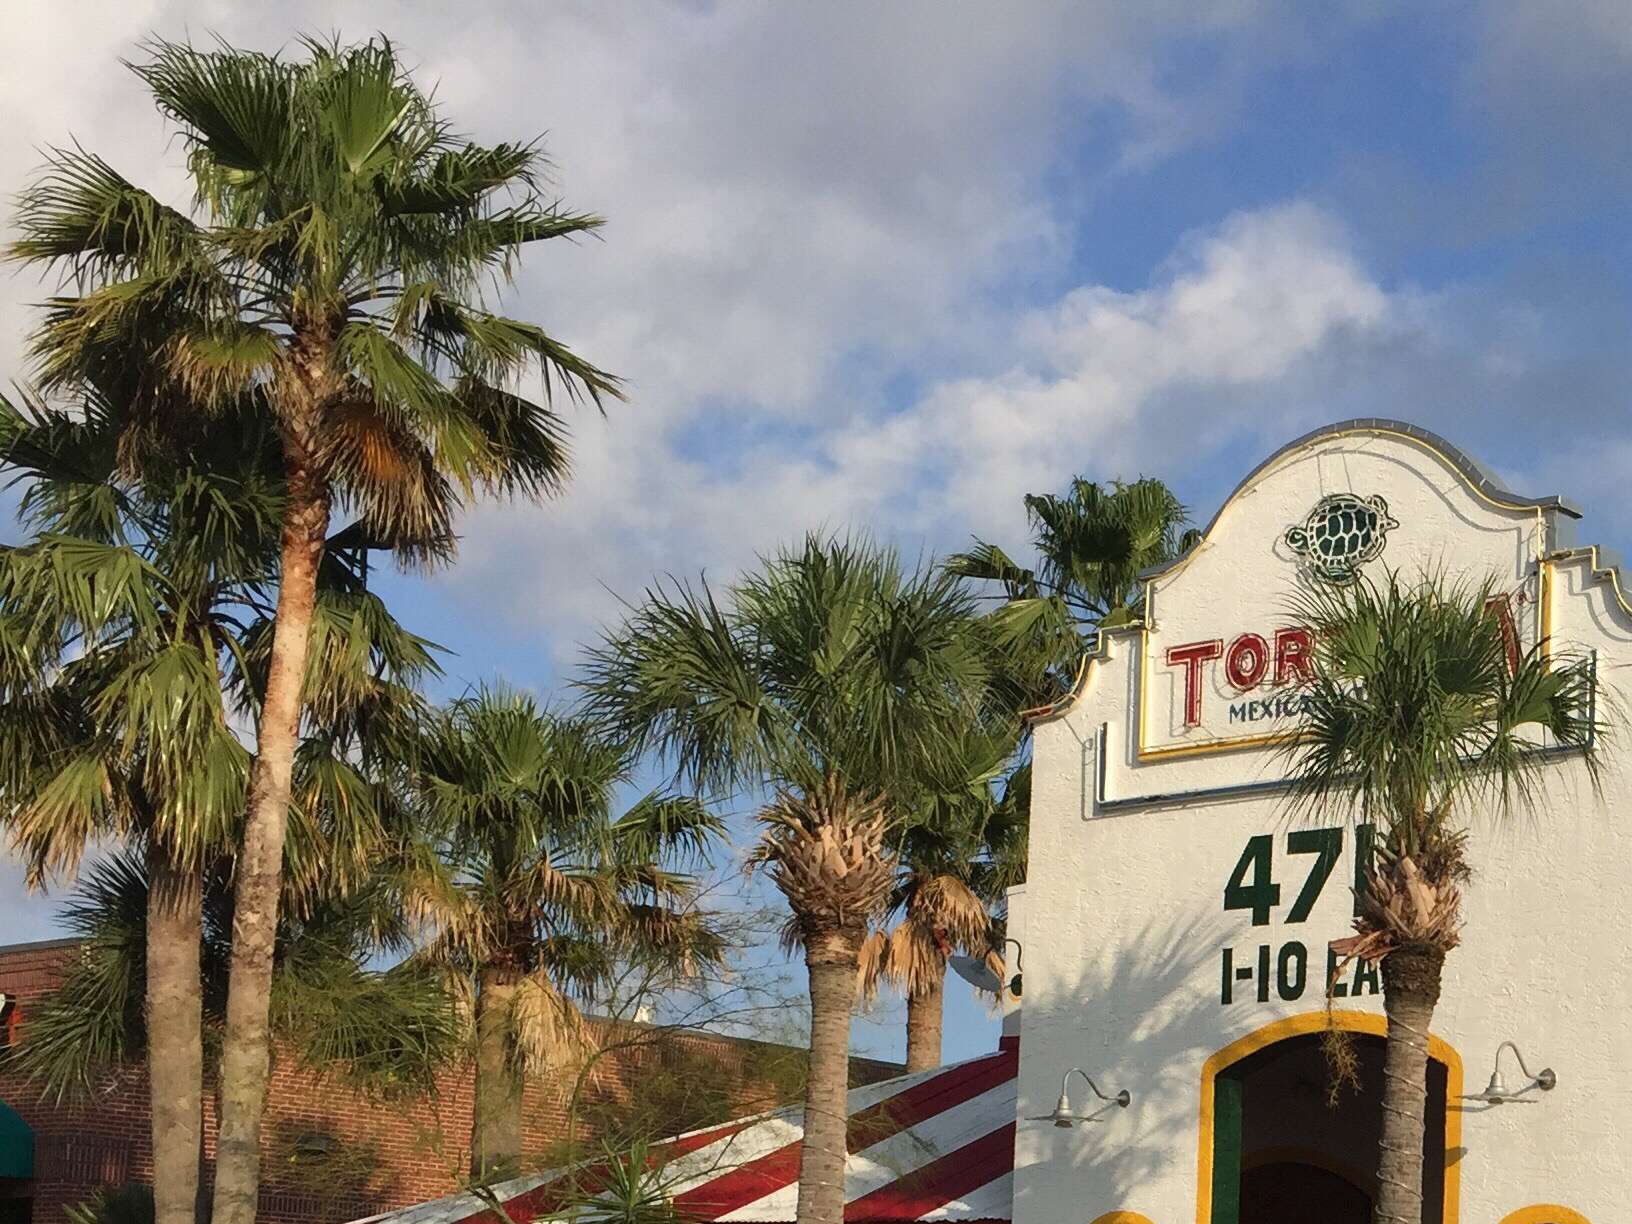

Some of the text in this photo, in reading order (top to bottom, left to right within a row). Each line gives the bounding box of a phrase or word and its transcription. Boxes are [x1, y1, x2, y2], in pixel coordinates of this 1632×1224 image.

[1165, 591, 1524, 727] TORA
[1224, 824, 1377, 926] 471
[1221, 940, 1380, 1005] I-10 EA
